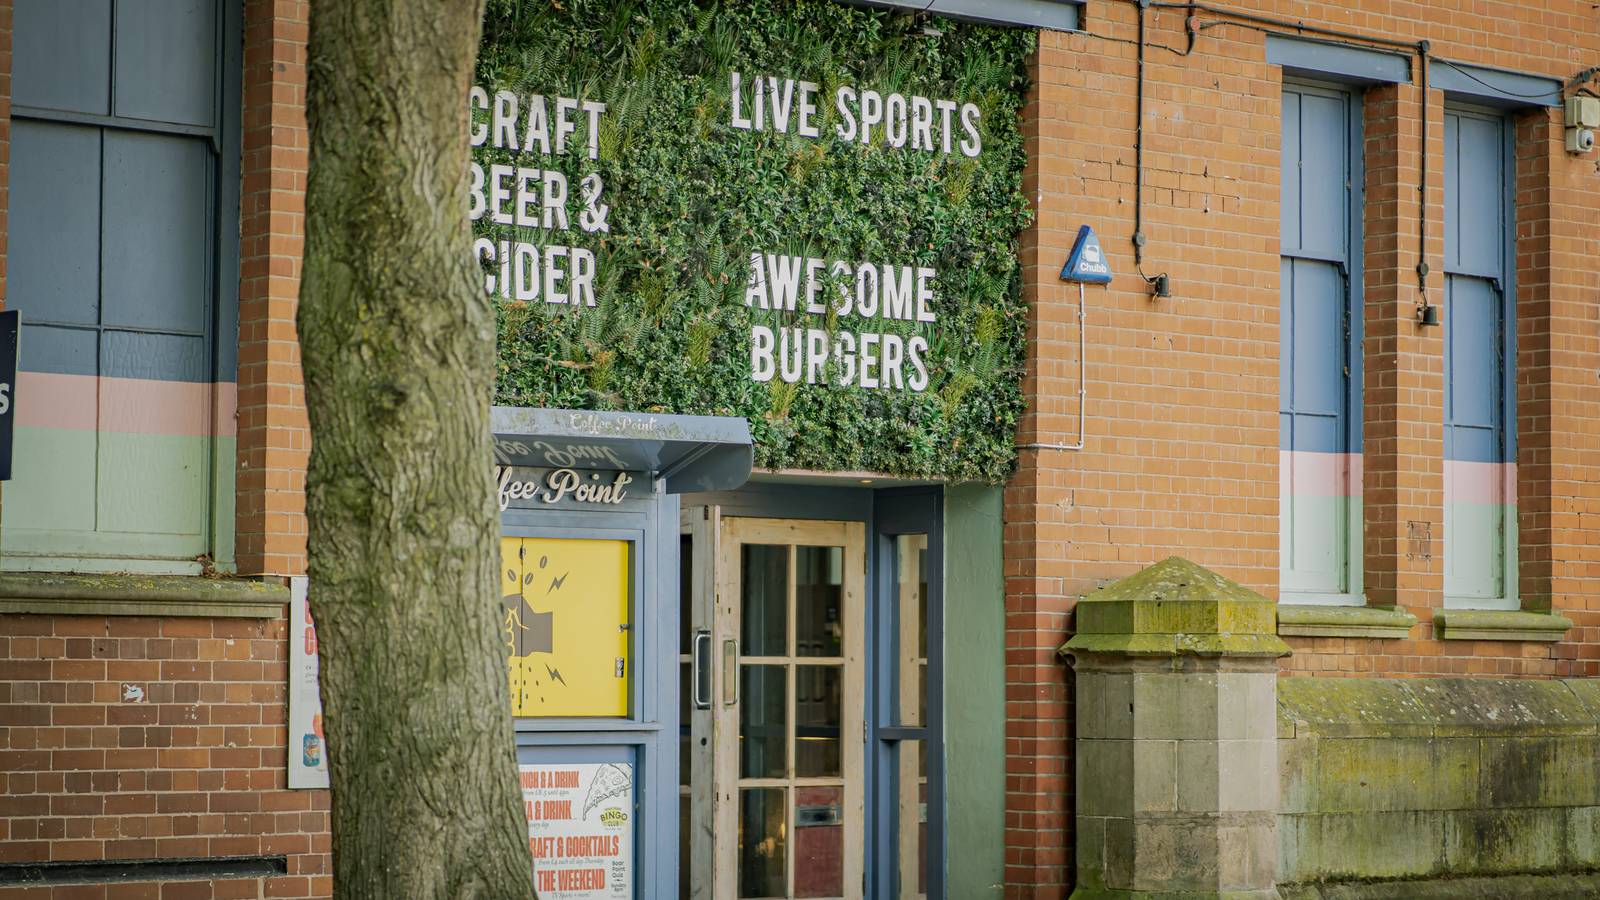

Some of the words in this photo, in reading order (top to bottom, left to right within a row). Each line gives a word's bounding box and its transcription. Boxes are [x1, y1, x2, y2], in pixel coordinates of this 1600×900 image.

[469, 86, 606, 160] CRAFT
[731, 72, 819, 138] LIVE
[836, 86, 982, 158] SPORTS
[467, 162, 569, 230] BEER
[579, 172, 609, 233] &
[473, 238, 597, 307] CIDER
[1080, 262, 1107, 273] Chubb
[745, 253, 936, 322] AWESOME
[751, 325, 929, 392] BURGERS
[569, 413, 613, 435] Coffee
[615, 415, 658, 432] Point
[543, 469, 633, 504] Point
[548, 771, 554, 788] A
[555, 771, 580, 788] DRINK
[543, 800, 572, 820] DRINK
[600, 811, 628, 822] BINGO
[566, 835, 619, 857] COCKTAILS
[537, 870, 556, 892] THE
[558, 868, 605, 890] WEEKEND
